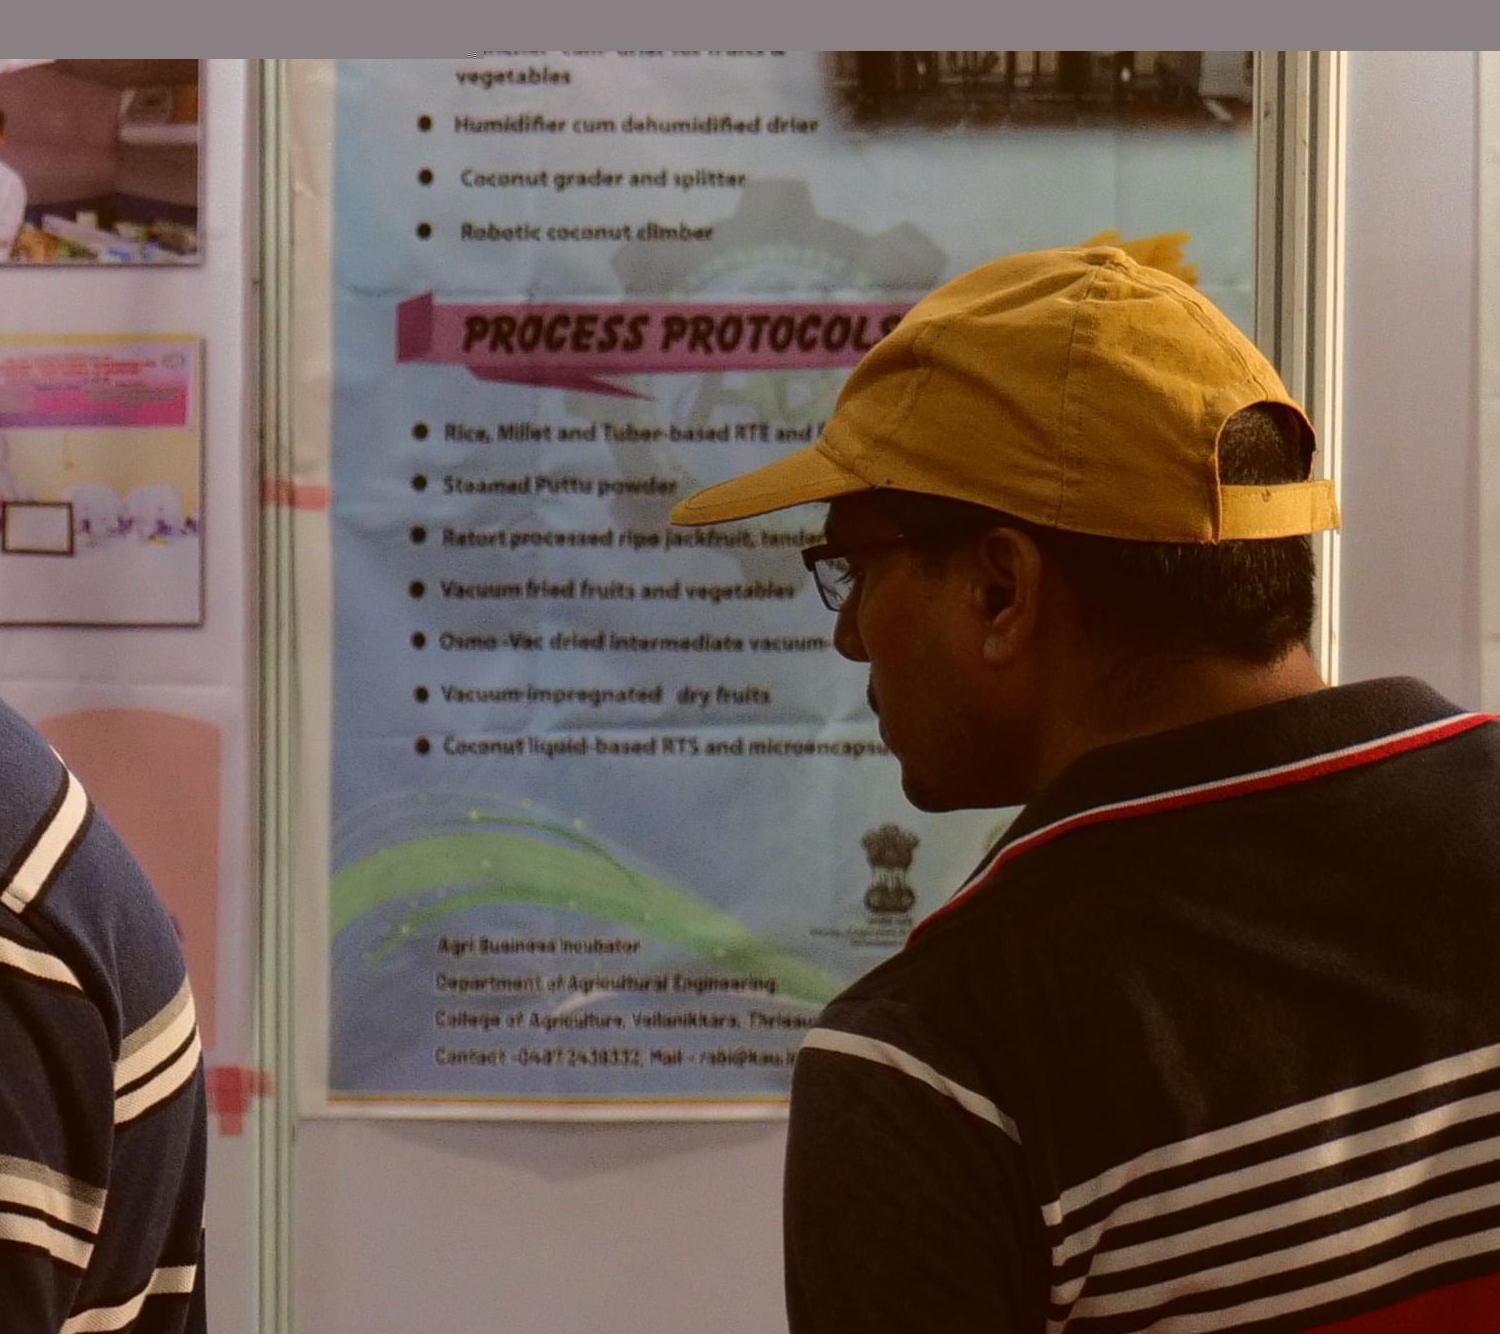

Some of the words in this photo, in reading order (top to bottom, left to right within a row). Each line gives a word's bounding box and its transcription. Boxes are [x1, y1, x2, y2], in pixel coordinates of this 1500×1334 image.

[456, 65, 571, 90] vegetables
[454, 114, 566, 134] Humidifier
[572, 119, 616, 134] cum
[621, 114, 760, 134] dehumidified
[766, 114, 819, 134] drier
[461, 169, 548, 188] Coconut
[554, 168, 622, 192] grader
[629, 169, 667, 188] and
[674, 168, 747, 192] splitter
[460, 222, 541, 241] Robotic
[547, 224, 630, 241] coconut
[636, 222, 714, 241] climber
[462, 314, 649, 354] PROCESS
[444, 423, 491, 445] Rice,
[498, 423, 552, 442] Millet
[558, 424, 596, 442] and
[775, 424, 812, 442] and
[443, 476, 529, 495] Steamed
[599, 476, 677, 498] powder
[510, 529, 614, 551] processed
[440, 580, 521, 599] Vacuum
[527, 579, 575, 598] fried
[581, 579, 635, 598] fruits
[642, 580, 680, 599] and
[686, 580, 796, 604] vegetables
[550, 631, 603, 651] dried
[610, 631, 743, 652] intermediate
[677, 685, 710, 708] dry
[716, 685, 770, 705] fruits
[443, 737, 524, 756] Coconut
[662, 738, 700, 756] RTS
[707, 738, 743, 756] and
[438, 938, 474, 956] Agri
[435, 974, 541, 992] Department
[547, 973, 564, 990] of
[506, 1011, 524, 1029] of
